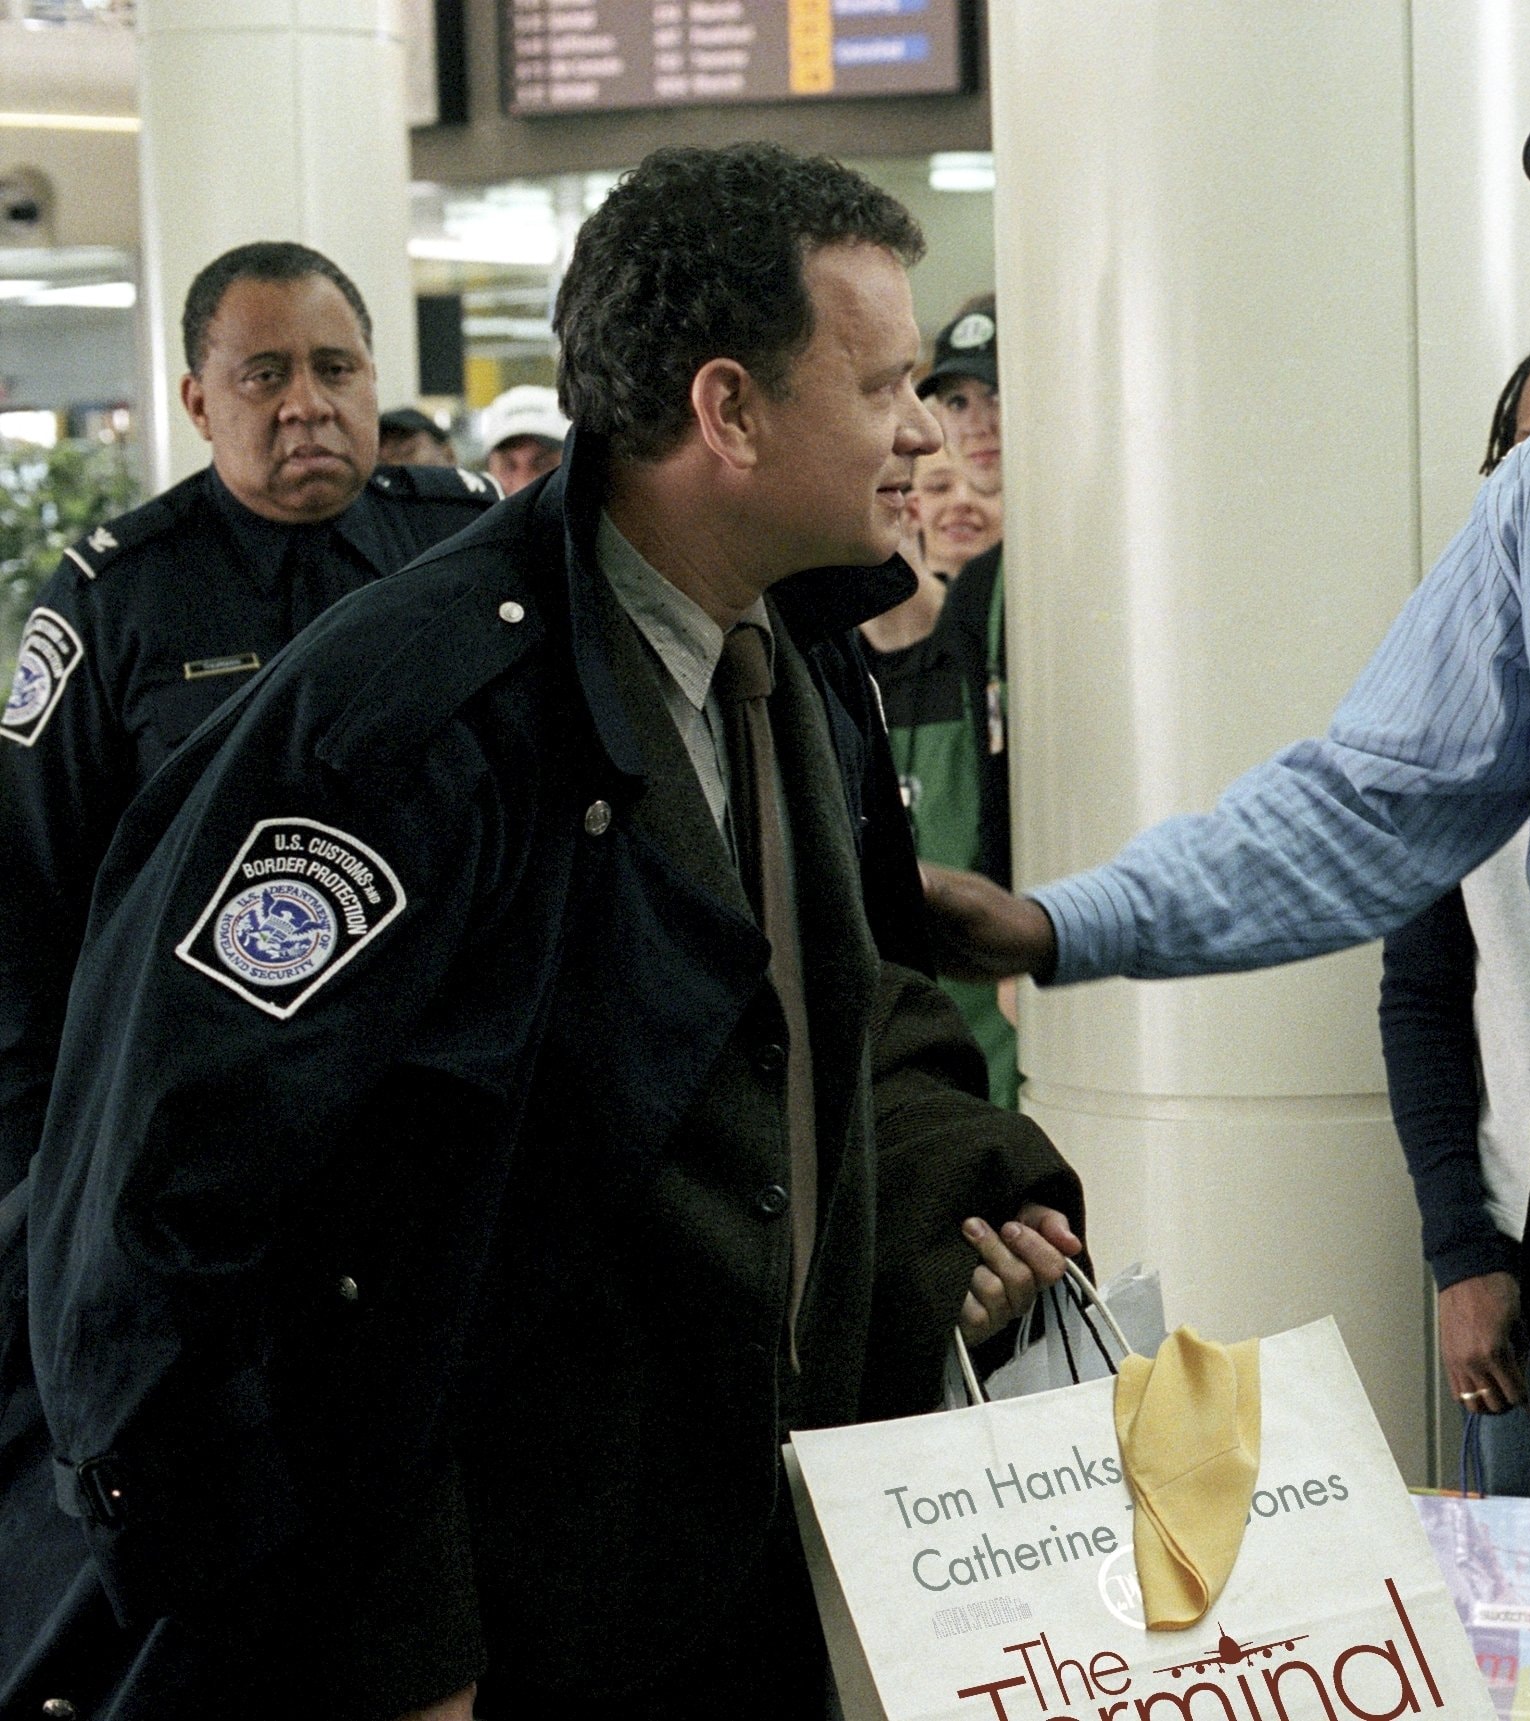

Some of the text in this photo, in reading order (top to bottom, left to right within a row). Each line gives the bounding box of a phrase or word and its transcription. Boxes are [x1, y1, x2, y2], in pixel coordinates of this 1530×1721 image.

[242, 857, 368, 936] BORDER PROTECTION
[274, 834, 381, 904] U.S. CUSTOMS AND
[220, 913, 250, 971] HOMELAND
[270, 885, 331, 932] DEPARTMENT
[320, 934, 331, 950] OF
[250, 959, 314, 979] SECURITY
[884, 1445, 1123, 1529] Tom Hanks
[912, 1525, 1118, 1592] Catherine
[1245, 1474, 1349, 1526] ones
[957, 1577, 1444, 1721] inal
[1003, 1632, 1131, 1711] The
